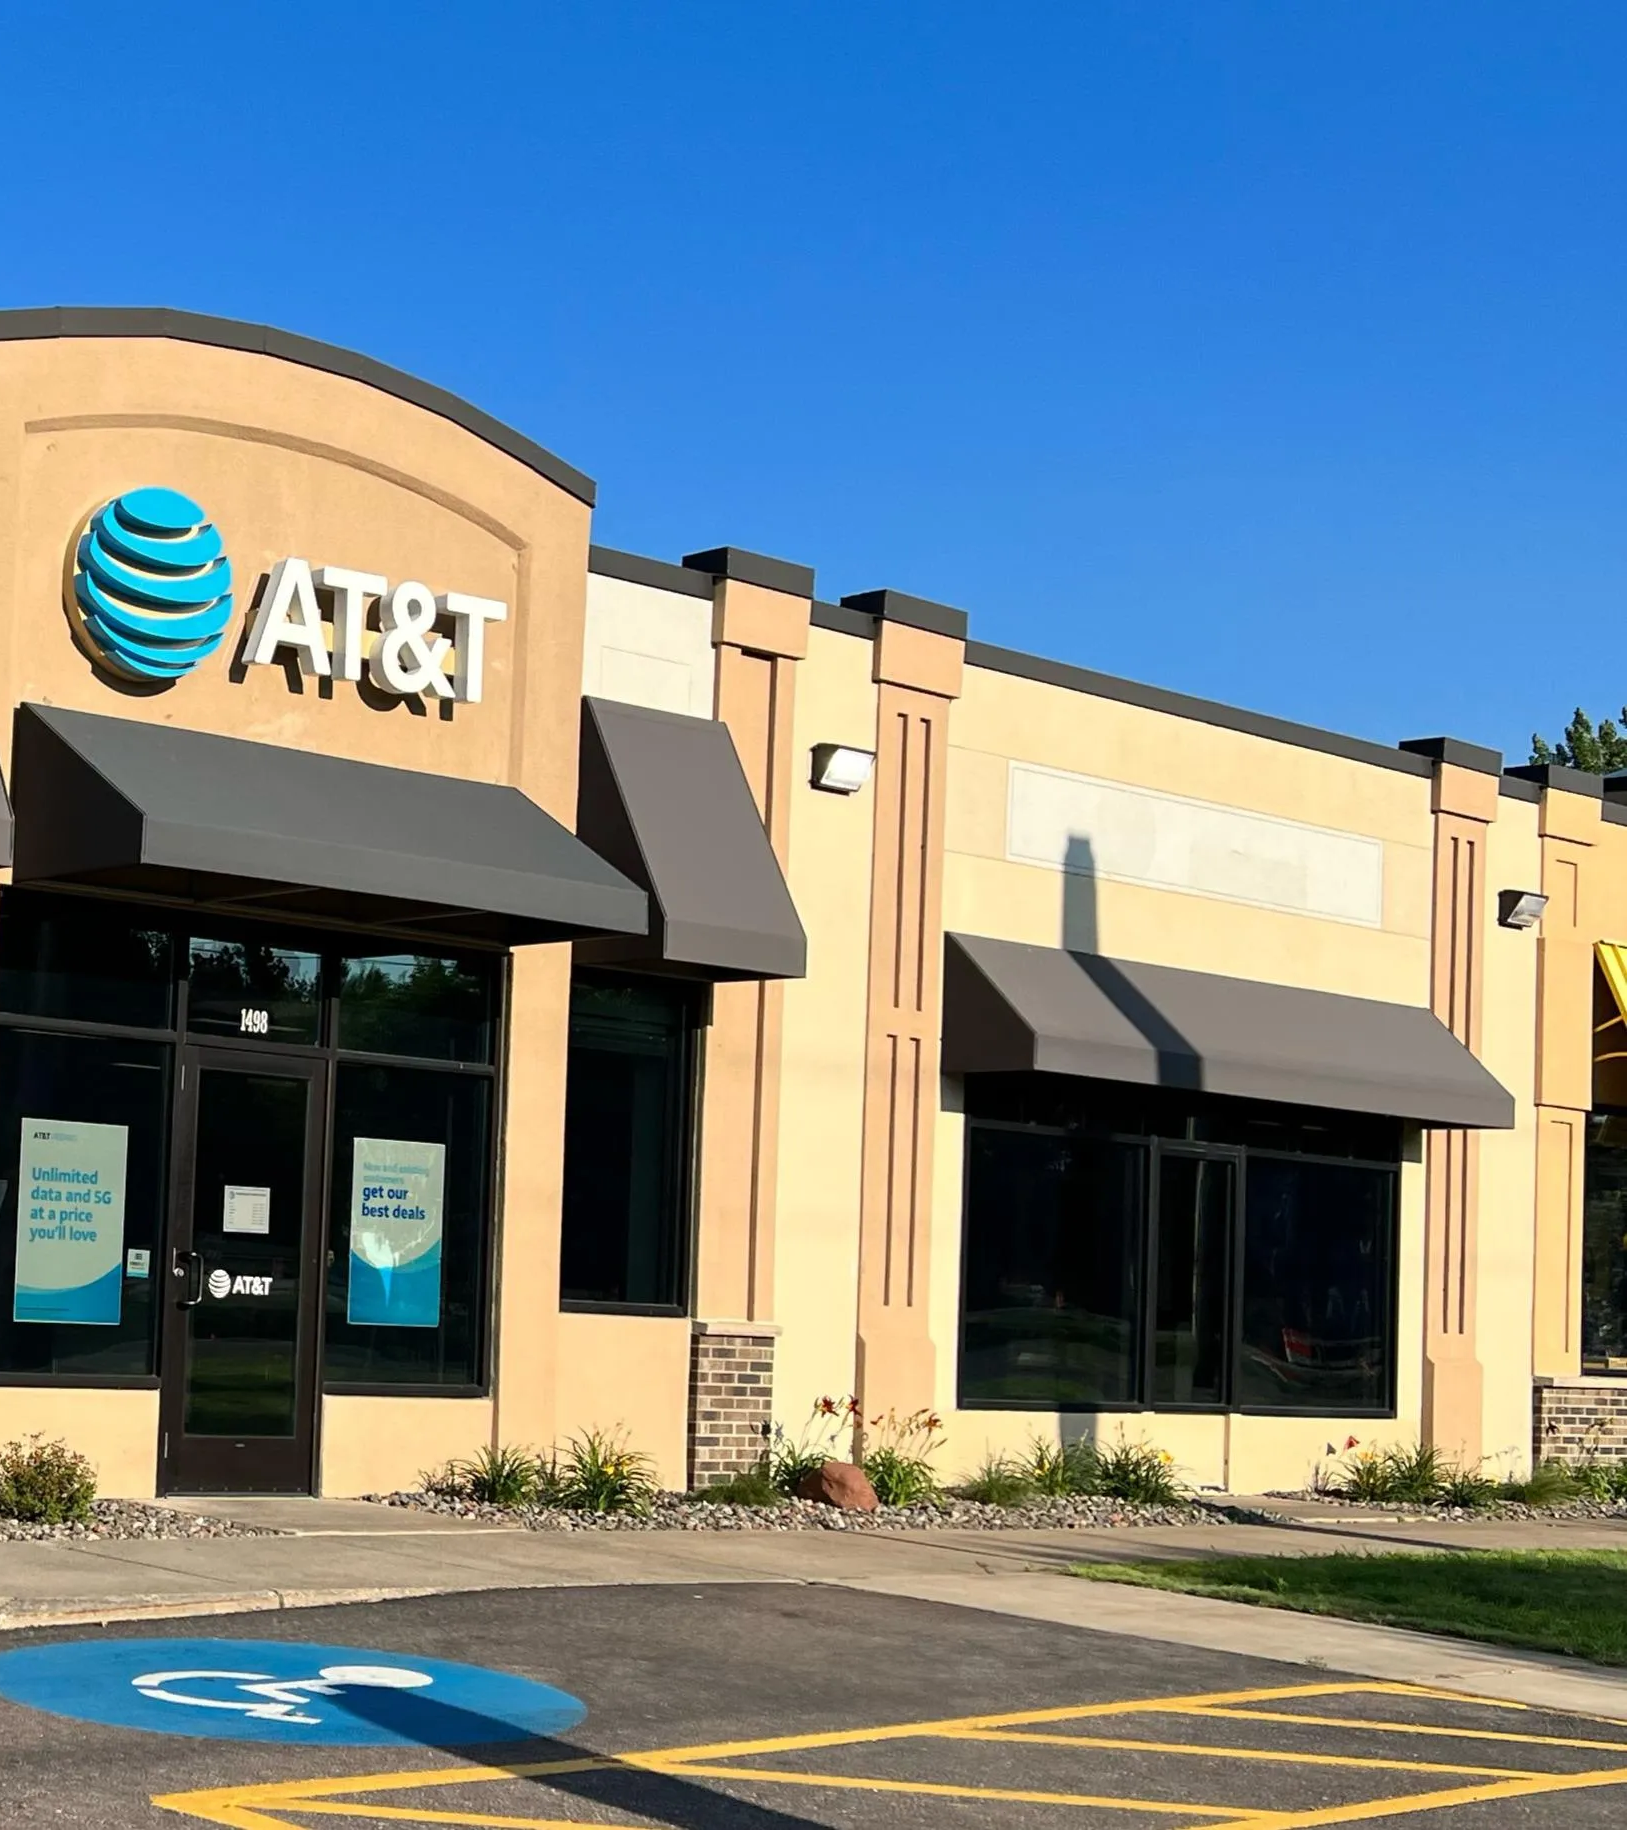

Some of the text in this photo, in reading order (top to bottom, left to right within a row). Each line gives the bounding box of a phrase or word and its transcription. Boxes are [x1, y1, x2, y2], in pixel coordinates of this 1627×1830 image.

[242, 557, 507, 703] AT&T
[240, 1008, 268, 1034] 1498
[32, 1167, 98, 1185] Unlimited
[31, 1186, 112, 1205] data and 5G
[363, 1185, 409, 1201] get our
[30, 1206, 93, 1225] at a price
[362, 1203, 426, 1220] best deals
[29, 1225, 97, 1242] you'll love
[232, 1275, 273, 1297] AT&T
